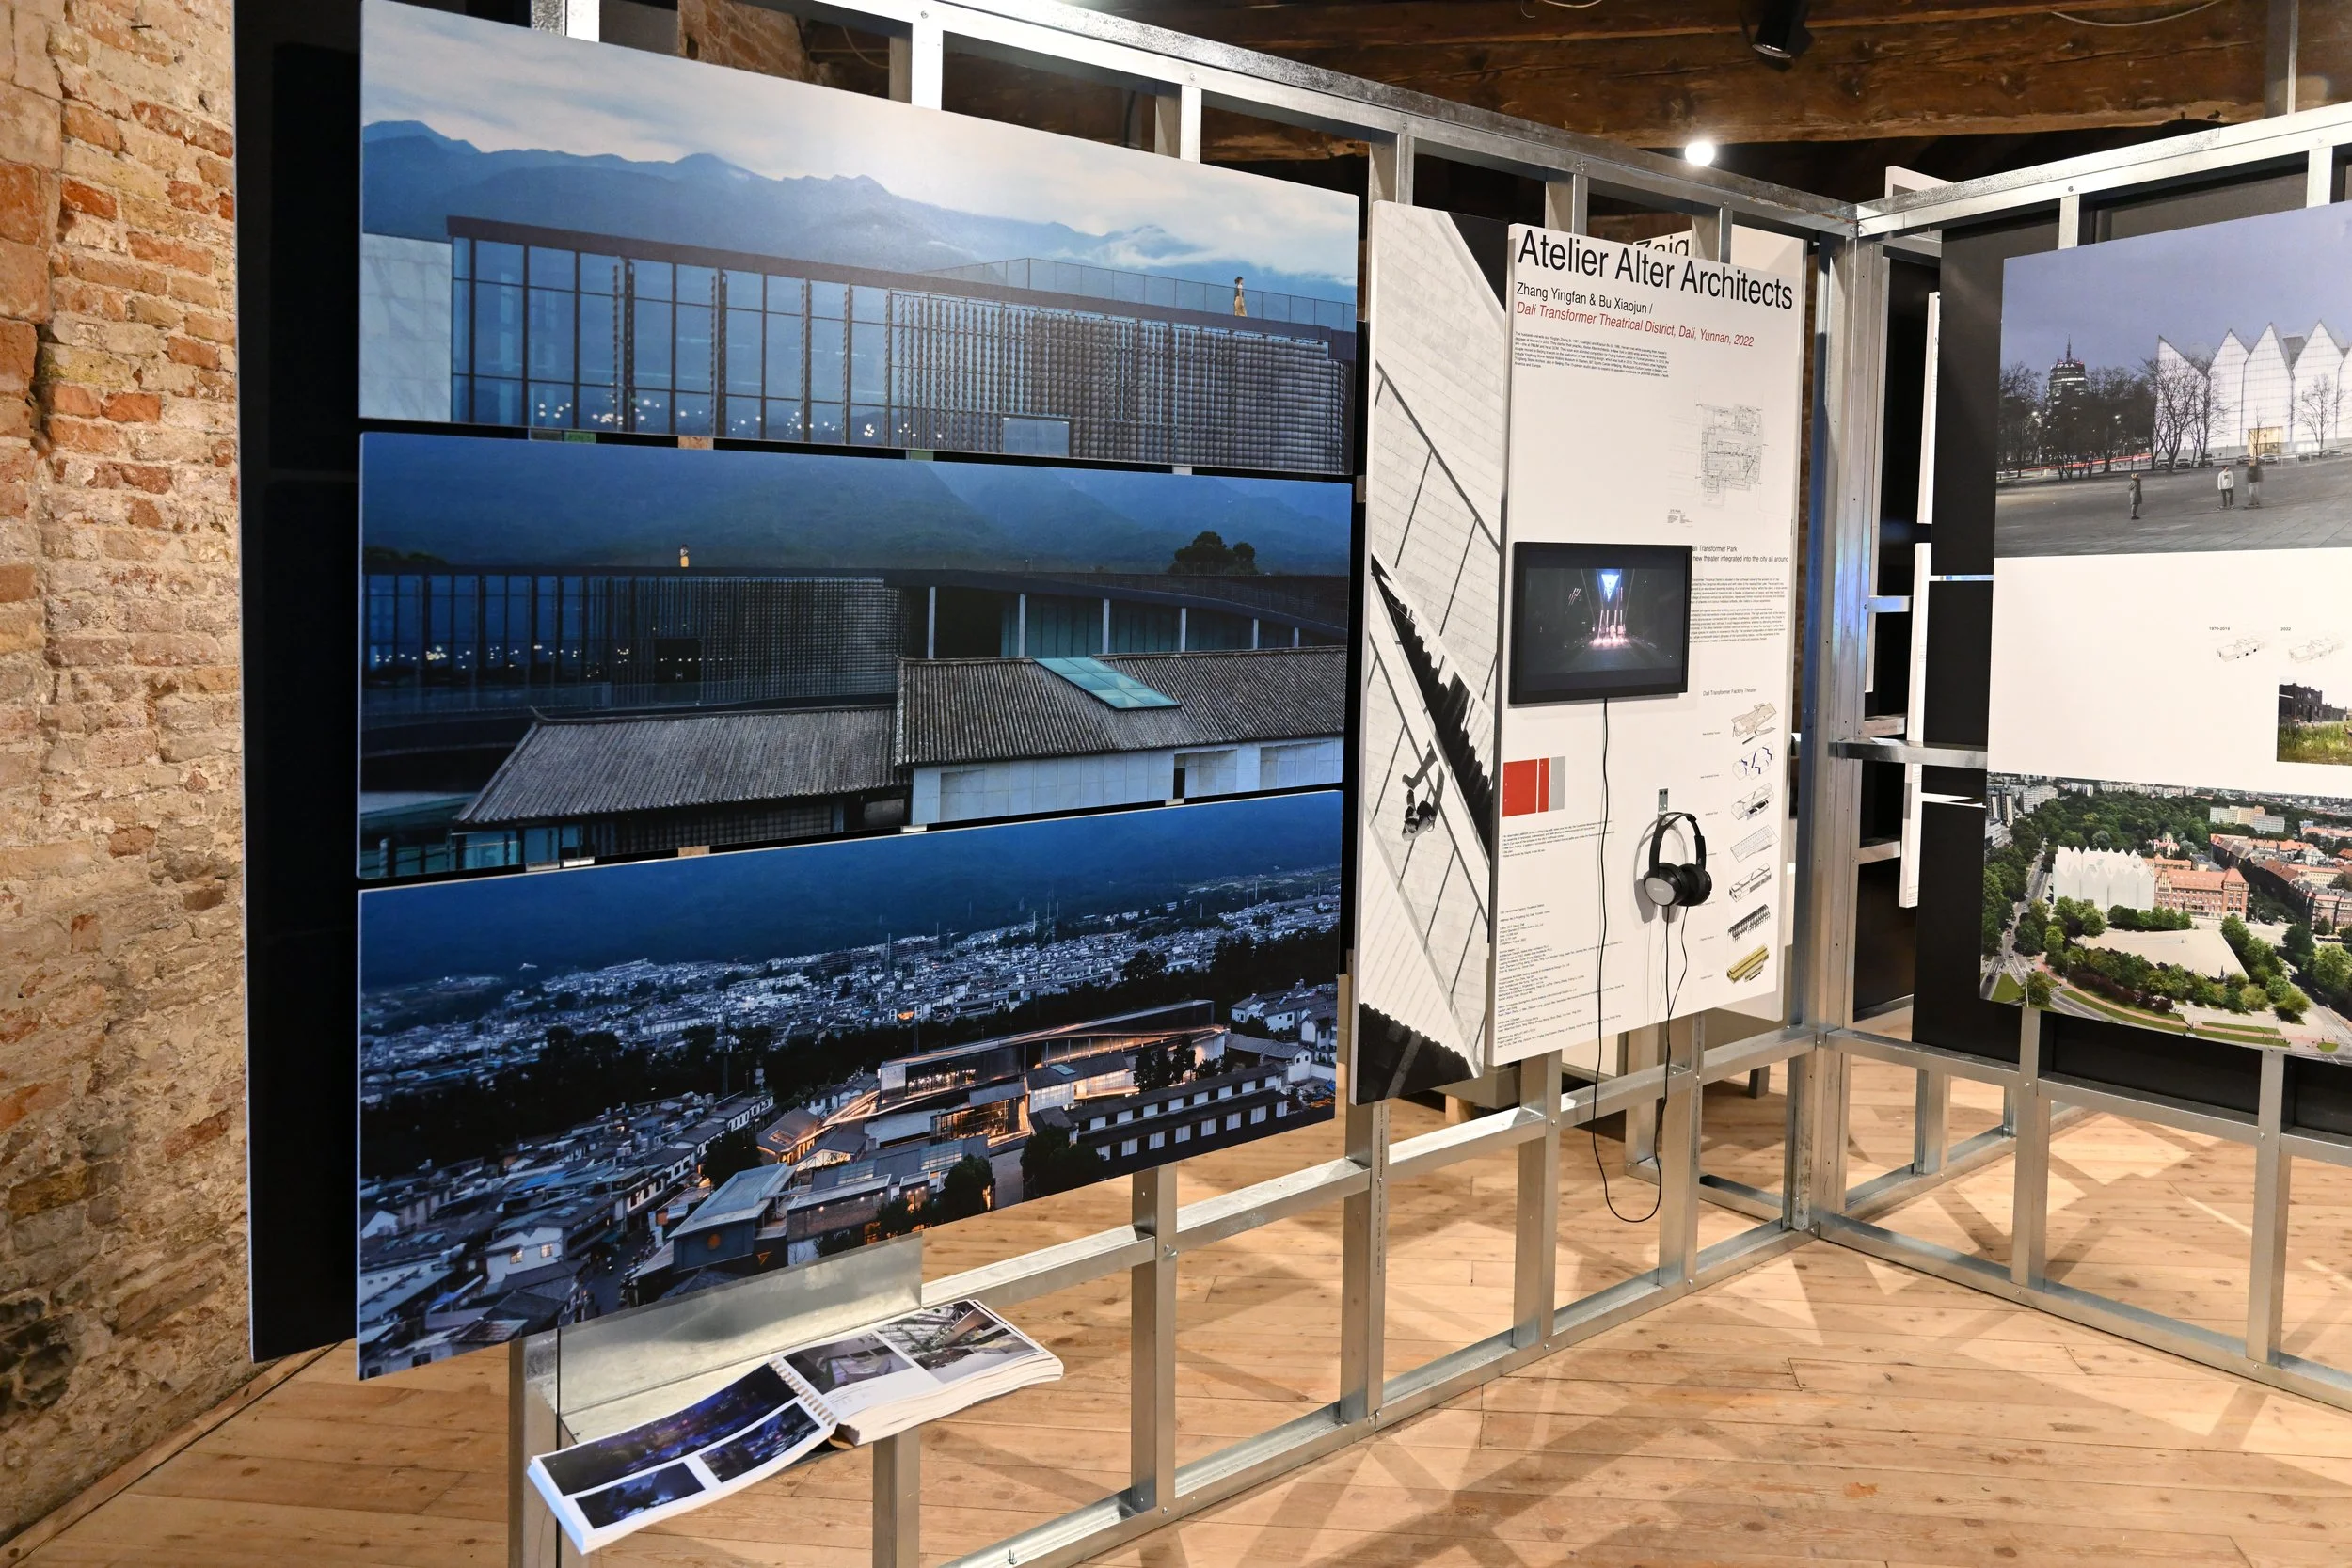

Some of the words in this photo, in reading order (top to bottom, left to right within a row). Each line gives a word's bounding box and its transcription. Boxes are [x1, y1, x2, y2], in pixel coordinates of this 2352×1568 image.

[1518, 230, 1609, 277] Atelier
[1614, 247, 1675, 289] Alter
[1680, 260, 1793, 310] Architects
[1517, 282, 1549, 302] Zhang
[1551, 287, 1586, 306] Yingfan
[1589, 293, 1596, 306] &
[1599, 295, 1612, 309] Bu
[1614, 297, 1647, 315] Xiaojun
[1649, 303, 1653, 314] /
[1517, 302, 1537, 316] Dali
[1539, 305, 1597, 325] Transformer
[1599, 313, 1644, 331] Theatrical
[1645, 320, 1677, 338] District,
[1678, 325, 1697, 341] Dali,
[1700, 328, 1732, 345] Yunnan,
[1734, 334, 1755, 347] 2022
[1720, 555, 1742, 563] integrated
[1759, 555, 1768, 563] city
